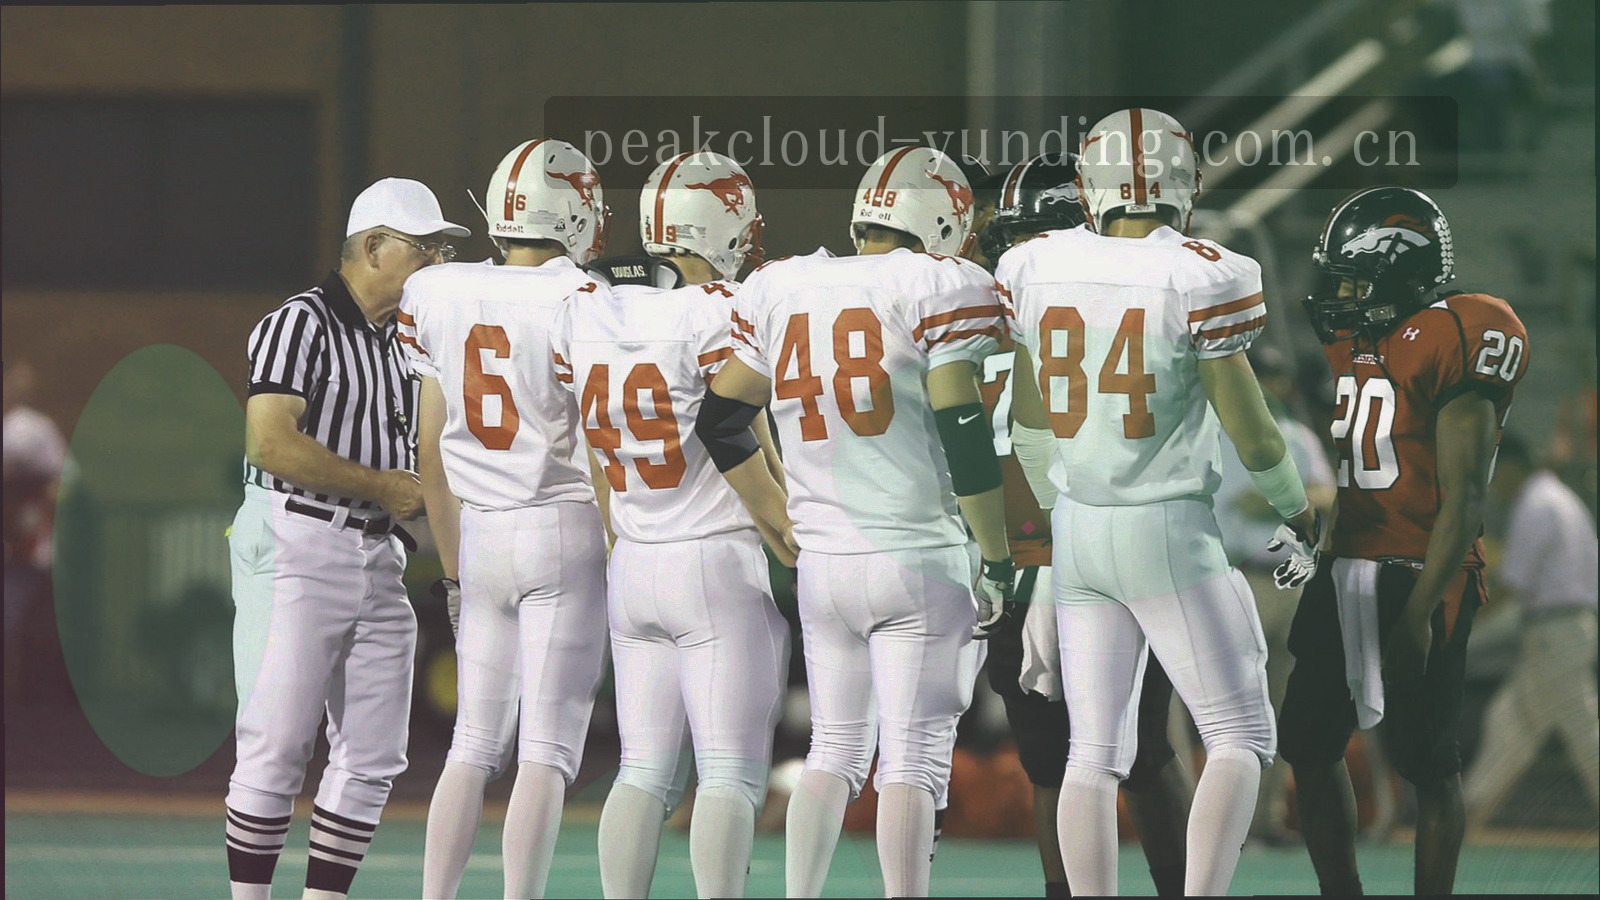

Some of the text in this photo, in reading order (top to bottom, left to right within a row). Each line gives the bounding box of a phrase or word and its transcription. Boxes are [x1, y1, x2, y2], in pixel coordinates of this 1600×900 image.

[515, 194, 526, 211] 6
[860, 209, 891, 221] Ridell
[463, 323, 519, 450] 6
[775, 307, 895, 442] 48
[1038, 306, 1157, 440] 84
[1475, 329, 1524, 382] 20
[581, 363, 687, 493] 49
[1330, 376, 1400, 489] 20
